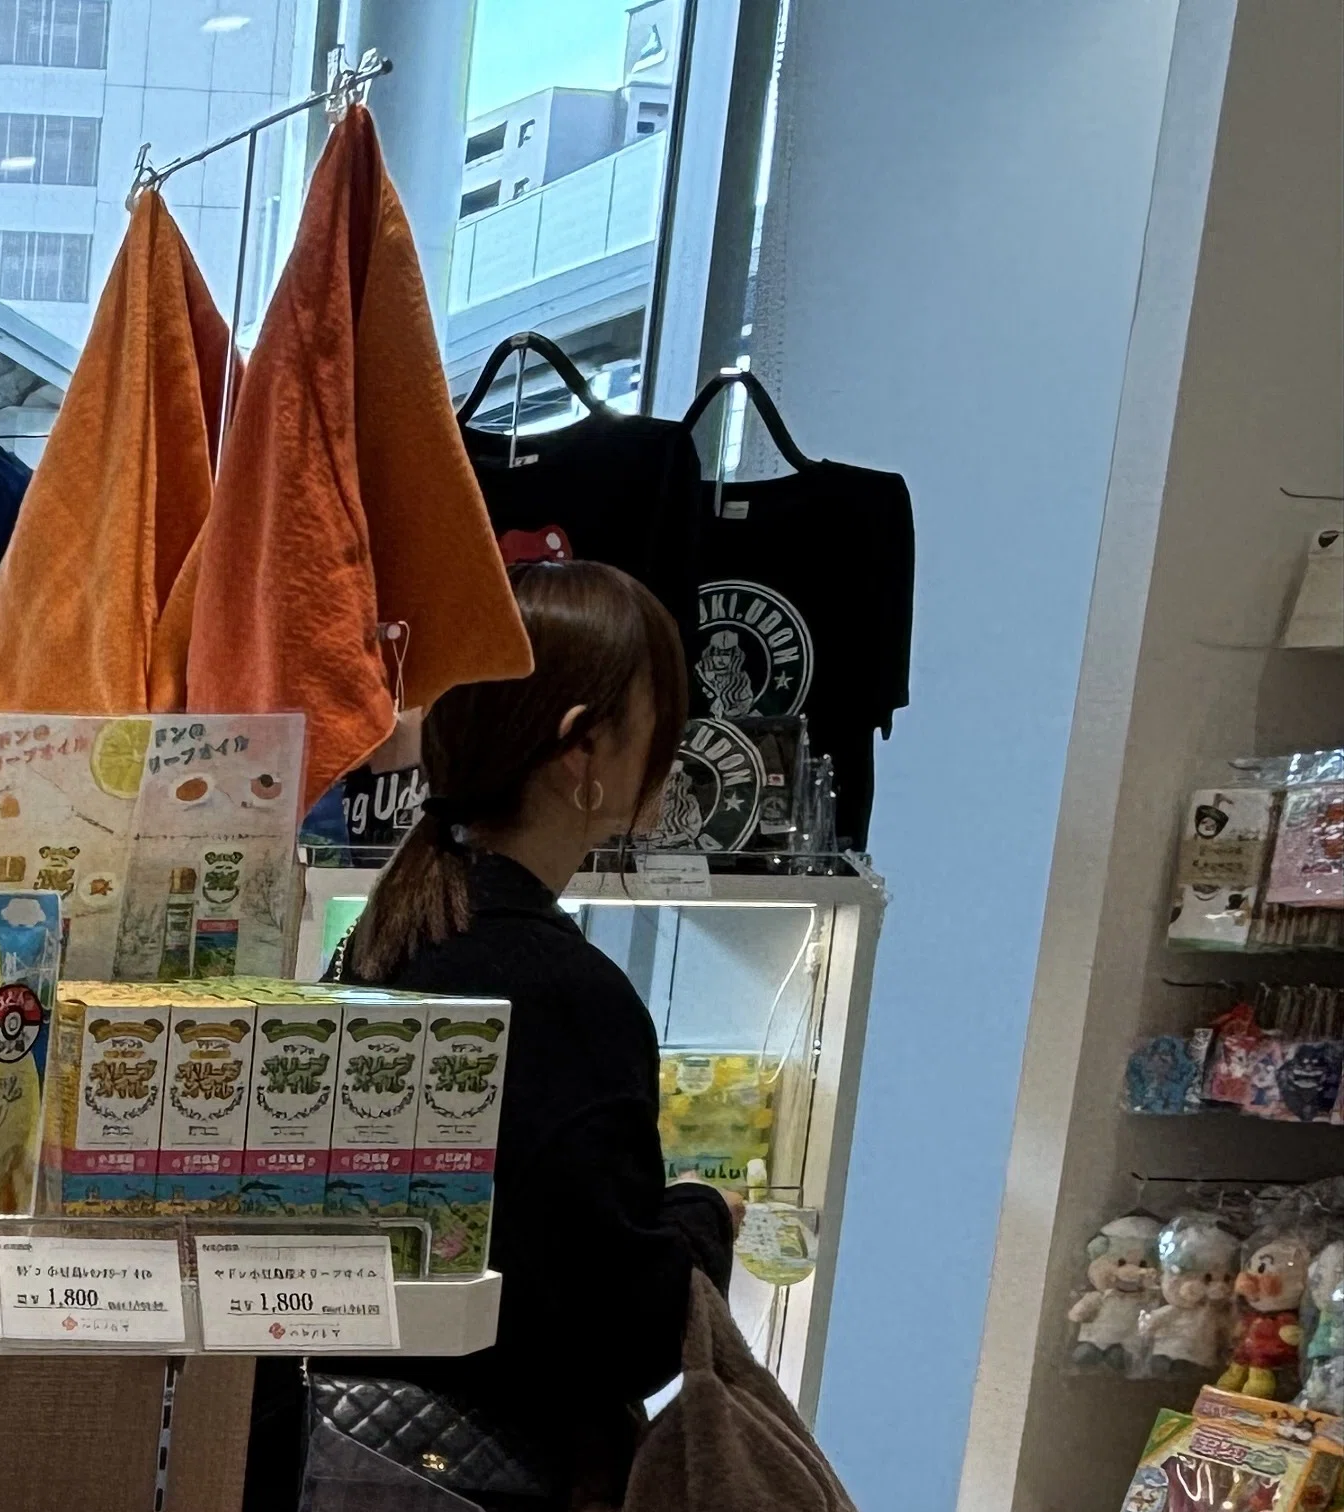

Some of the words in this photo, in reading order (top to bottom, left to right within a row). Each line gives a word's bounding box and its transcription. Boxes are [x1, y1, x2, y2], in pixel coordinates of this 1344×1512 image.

[154, 722, 206, 749] ドンの
[148, 734, 250, 775] リーブオイル
[47, 1287, 99, 1310] 1,800
[260, 1292, 315, 1314] 1,800
